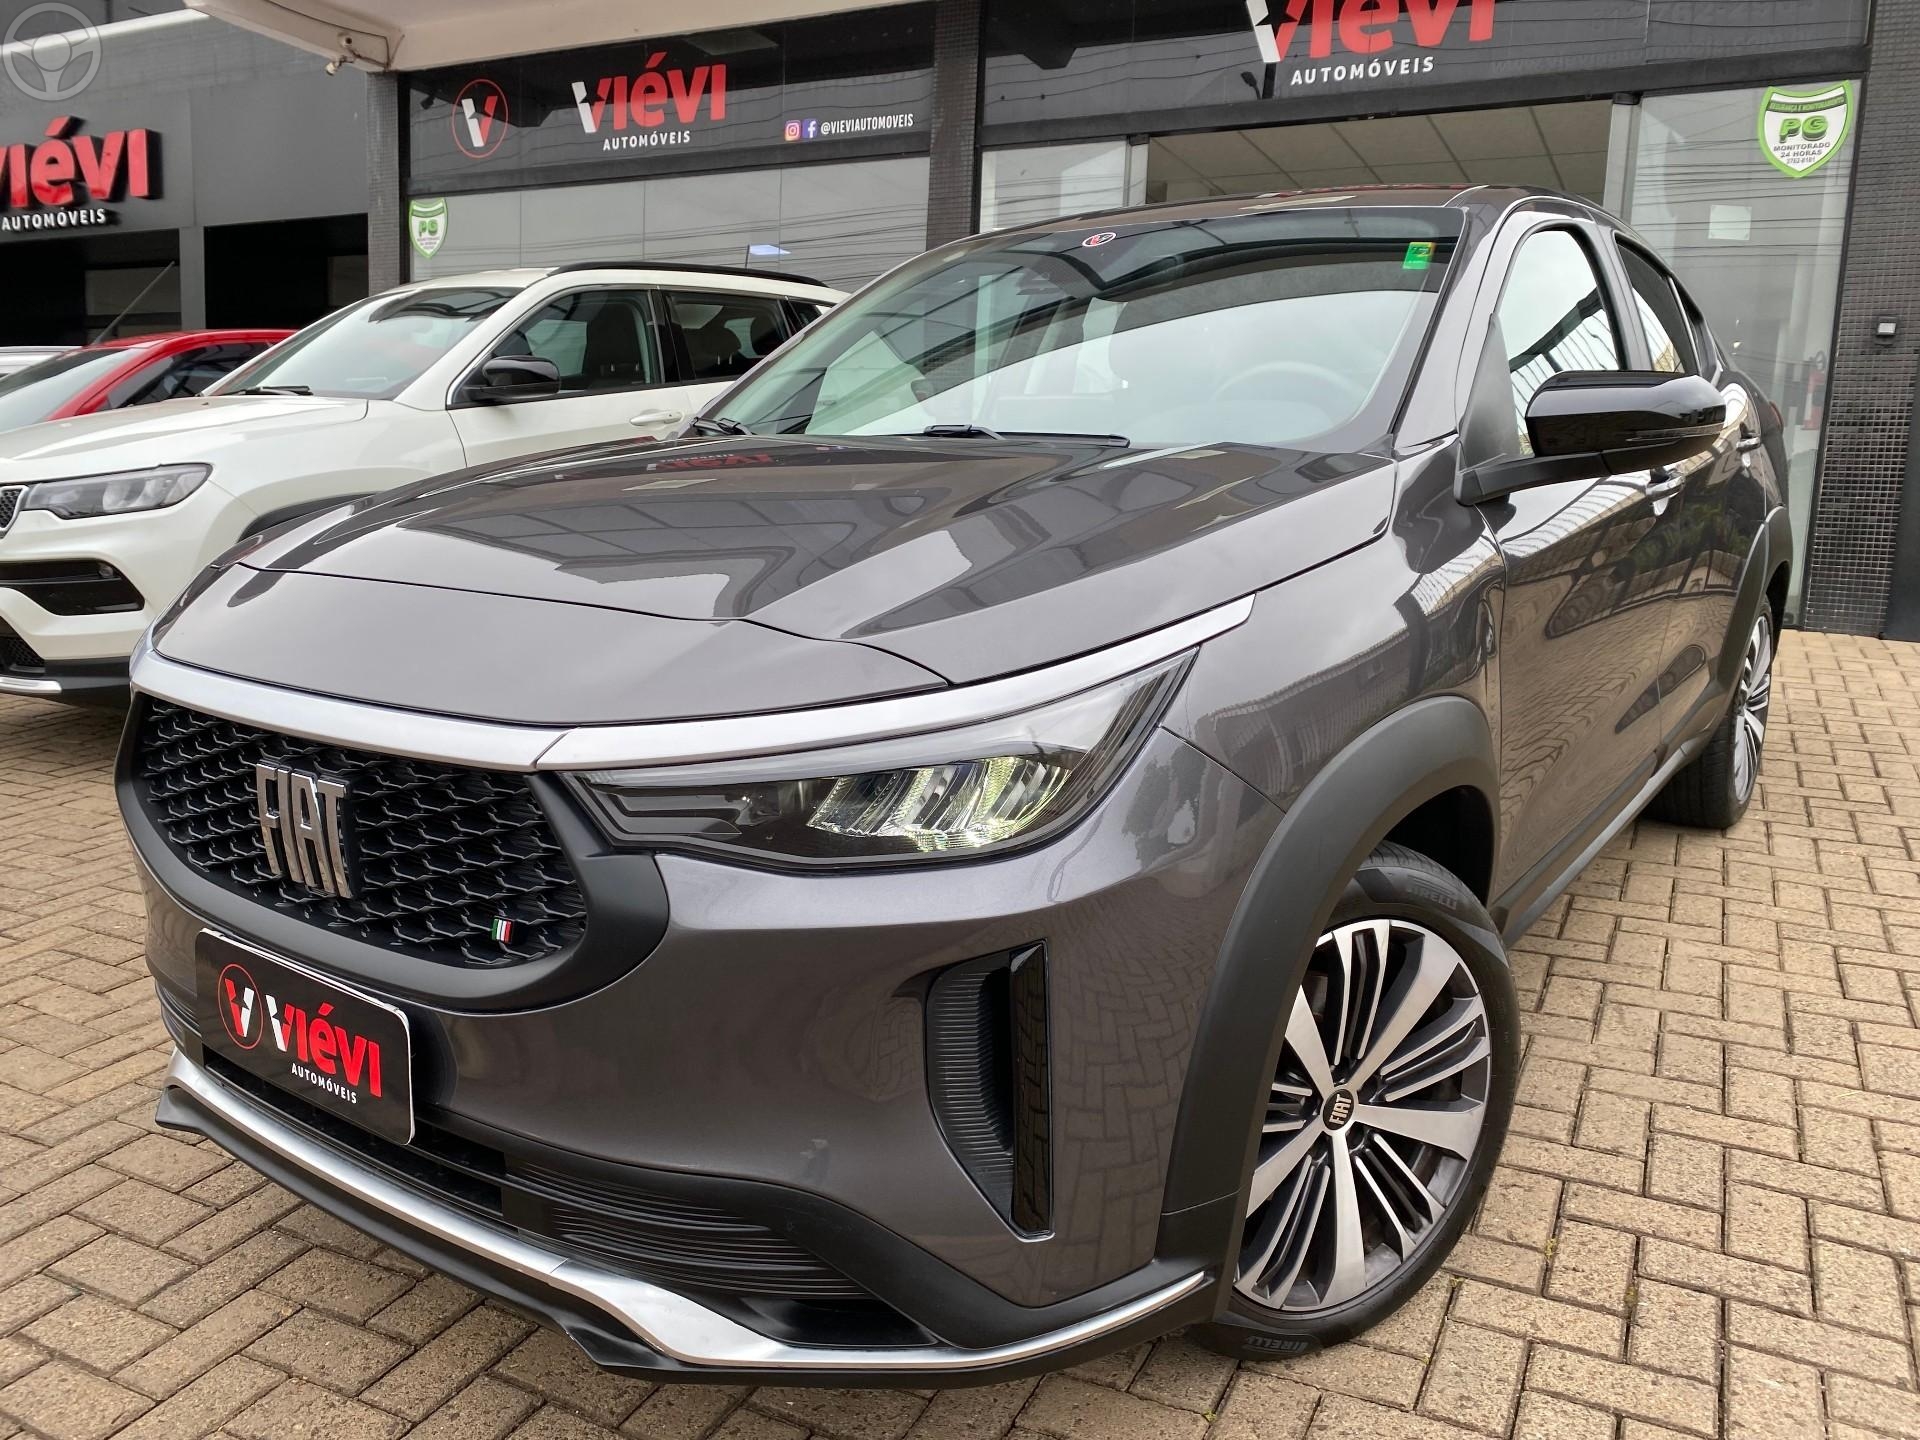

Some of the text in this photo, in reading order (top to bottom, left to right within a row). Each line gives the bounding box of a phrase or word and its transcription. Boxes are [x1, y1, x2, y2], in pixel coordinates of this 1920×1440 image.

[1290, 56, 1435, 86] AUTOMÓVEIS
[820, 113, 914, 135] @VIEVIAUTOMOVEIS
[1779, 114, 1829, 144] PG
[602, 130, 691, 151] AUTOMÓVEIS
[1773, 141, 1831, 152] MONITORADO
[1792, 149, 1823, 157] HORAS
[0, 115, 149, 208] IéVI
[1, 207, 106, 231] AUTOMÓVEIS
[256, 761, 353, 899] FIAT
[291, 1062, 357, 1104] AUTOMÓVEIS
[1329, 1093, 1352, 1125] FIAT
